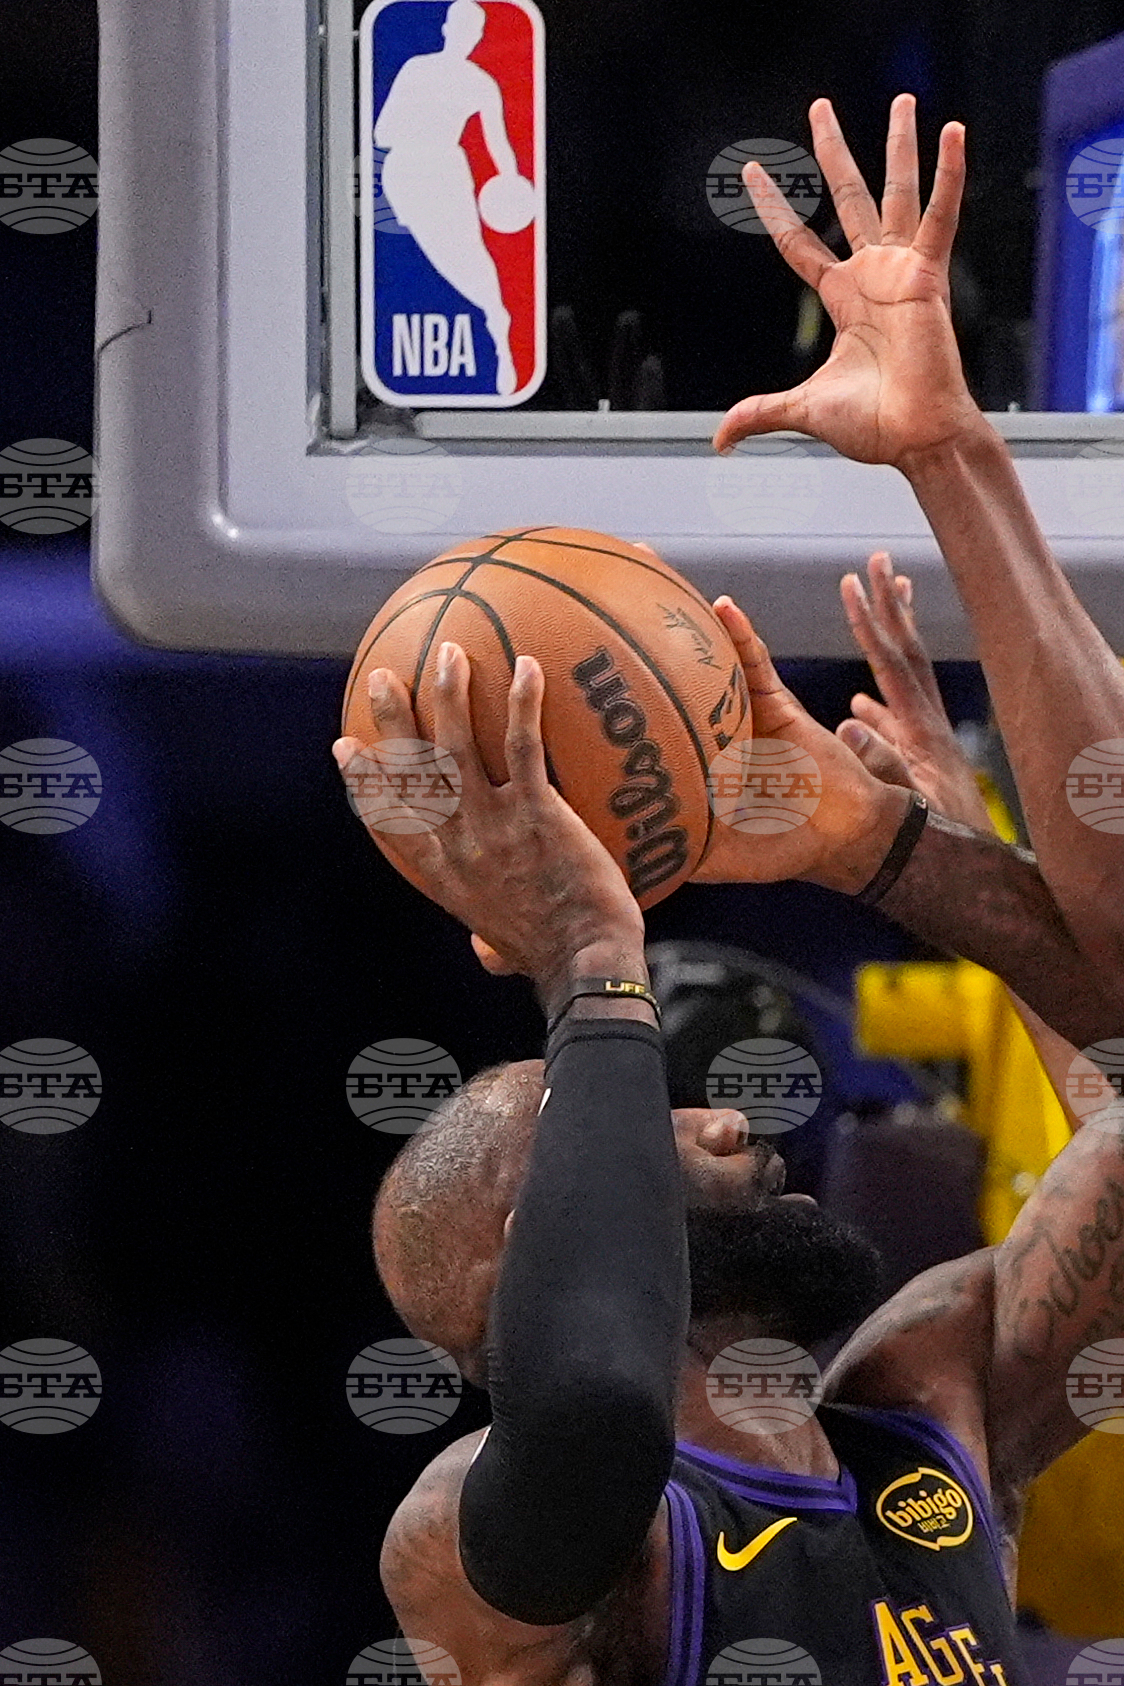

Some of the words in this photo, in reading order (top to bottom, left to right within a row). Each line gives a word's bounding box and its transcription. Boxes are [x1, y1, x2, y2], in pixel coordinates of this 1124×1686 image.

[392, 312, 477, 377] NBA
[572, 645, 689, 897] Wilson
[884, 1487, 963, 1528] bibigo
